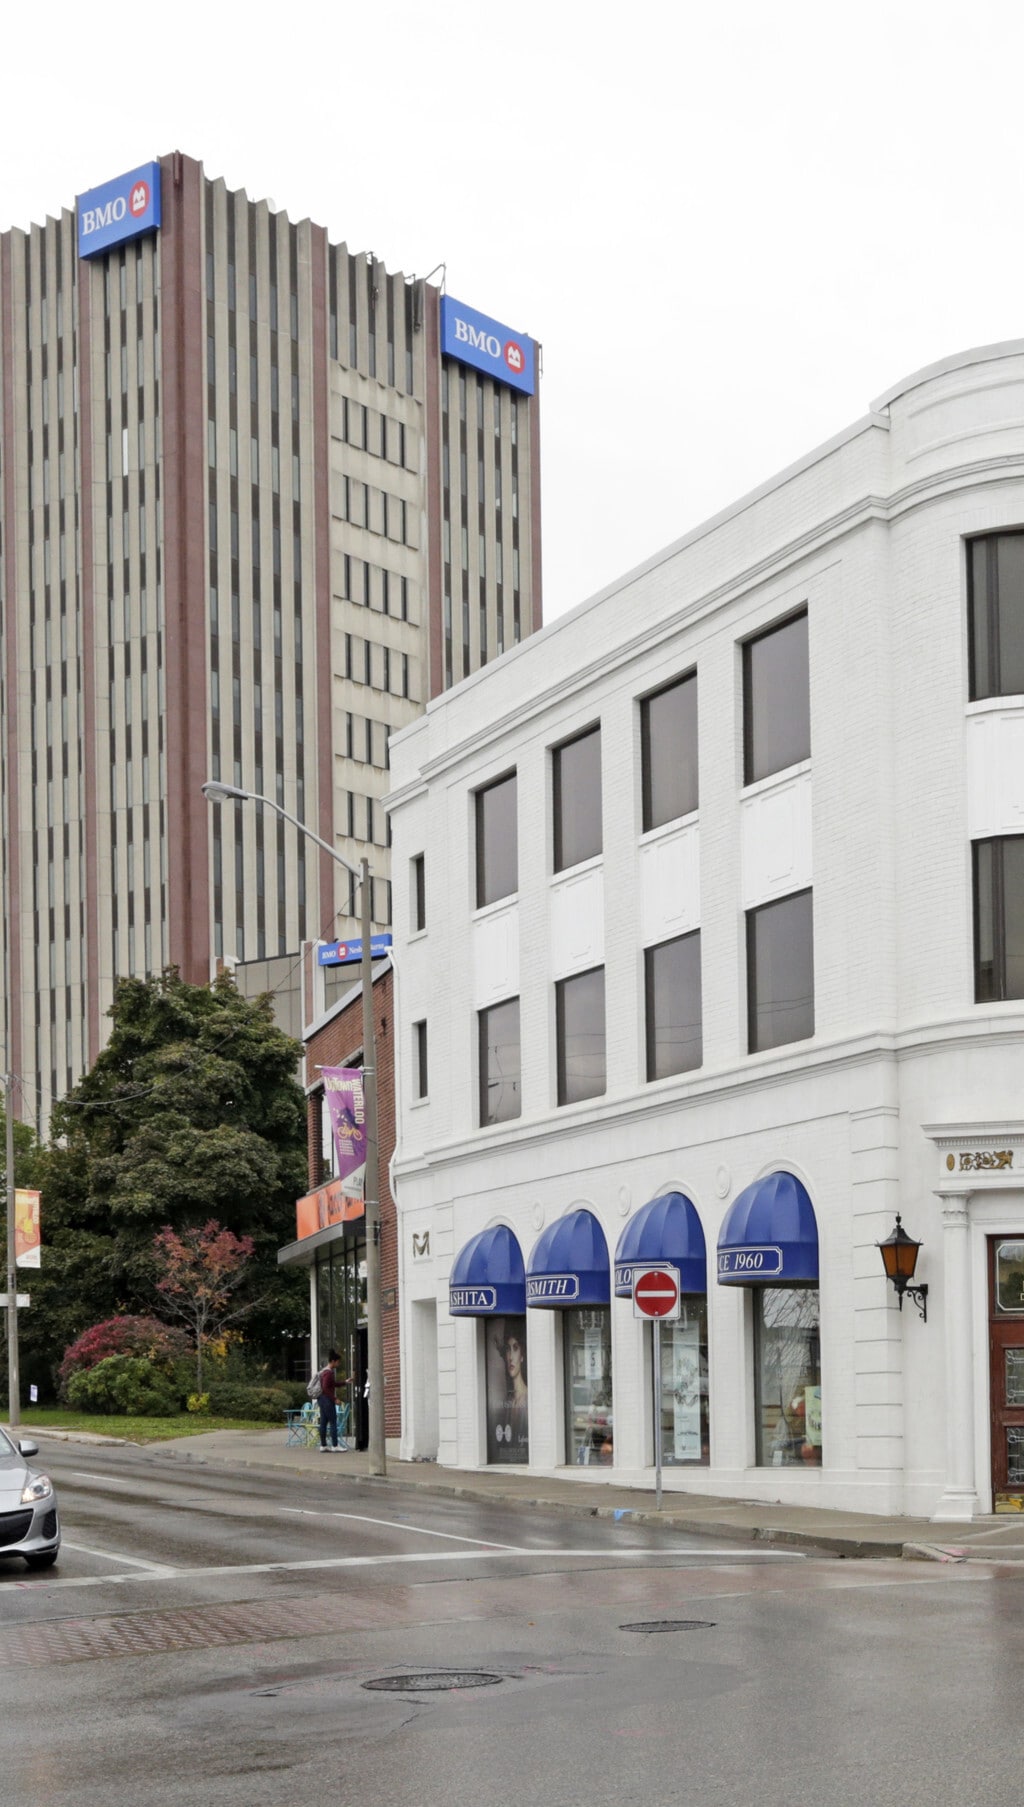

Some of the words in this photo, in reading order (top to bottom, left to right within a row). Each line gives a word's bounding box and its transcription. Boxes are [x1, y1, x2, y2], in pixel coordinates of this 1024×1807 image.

[82, 197, 126, 236] BMO
[454, 317, 501, 358] BMO
[734, 1253, 763, 1270] 1960
